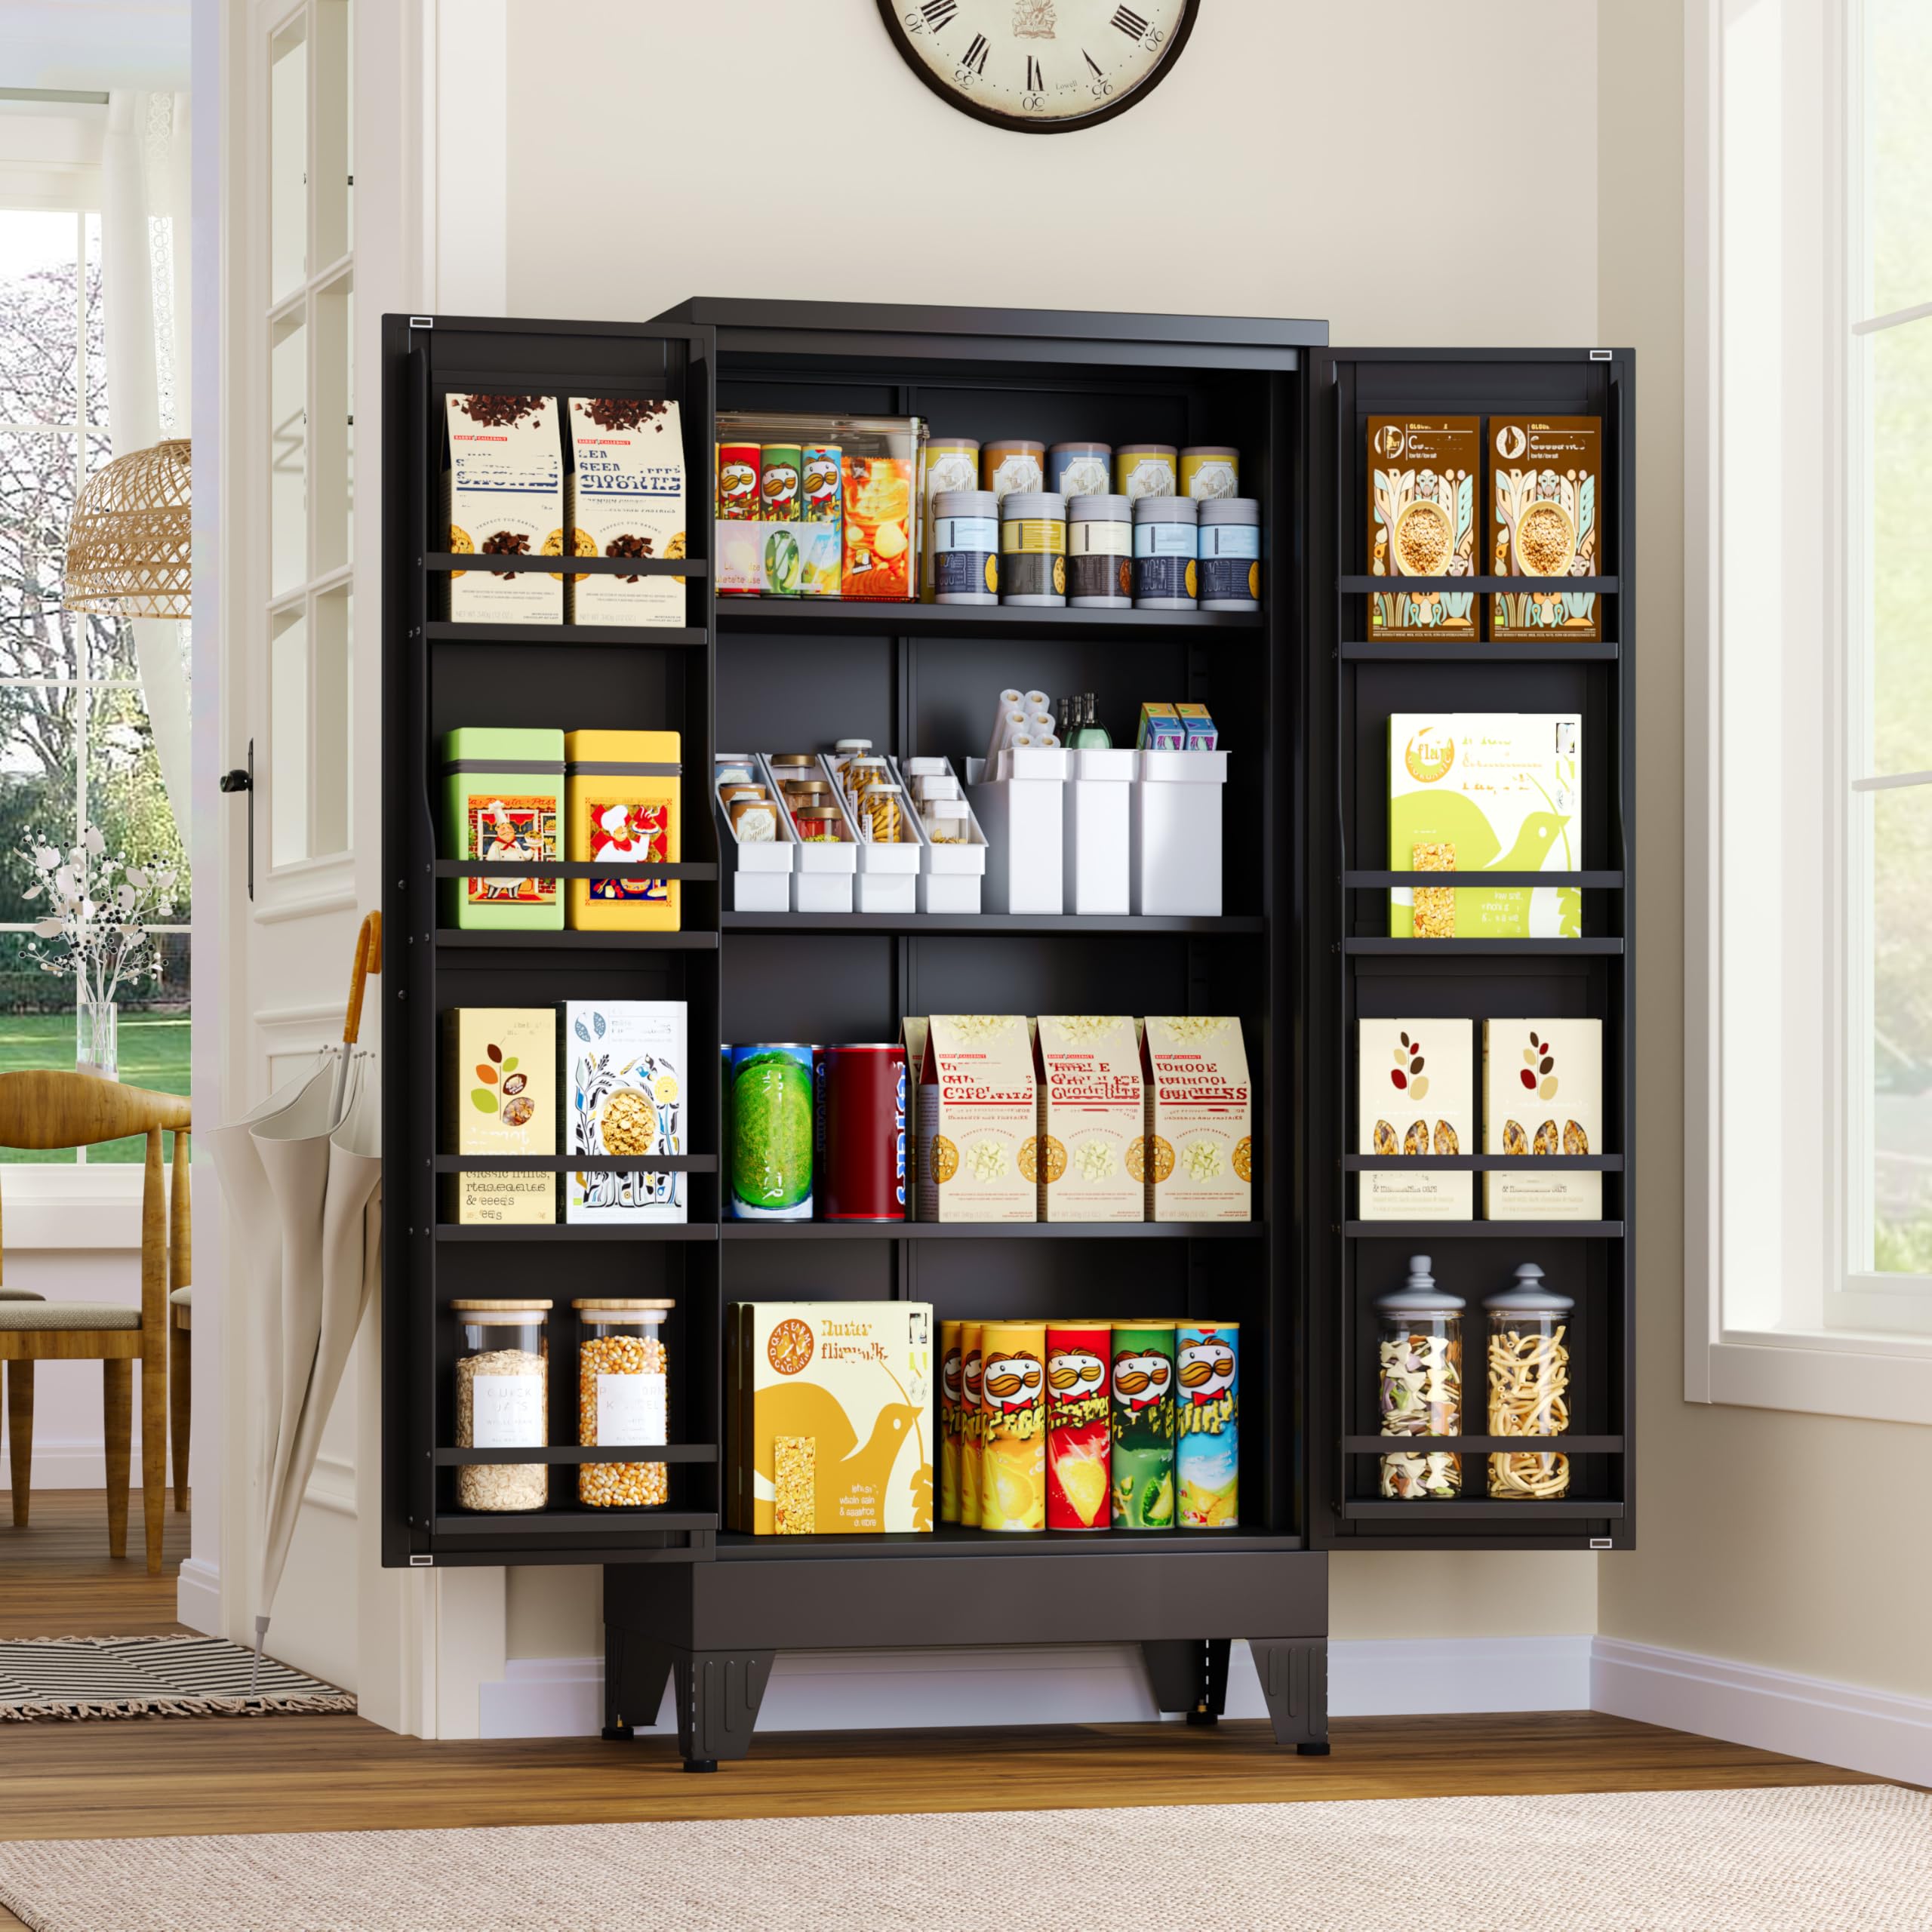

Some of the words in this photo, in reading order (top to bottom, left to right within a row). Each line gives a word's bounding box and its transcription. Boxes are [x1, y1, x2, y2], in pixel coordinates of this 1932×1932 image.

[905, 14, 922, 34] 40
[1145, 27, 1164, 51] 20
[951, 70, 974, 90] 35
[1091, 78, 1113, 101] 25
[1023, 97, 1045, 112] 30
